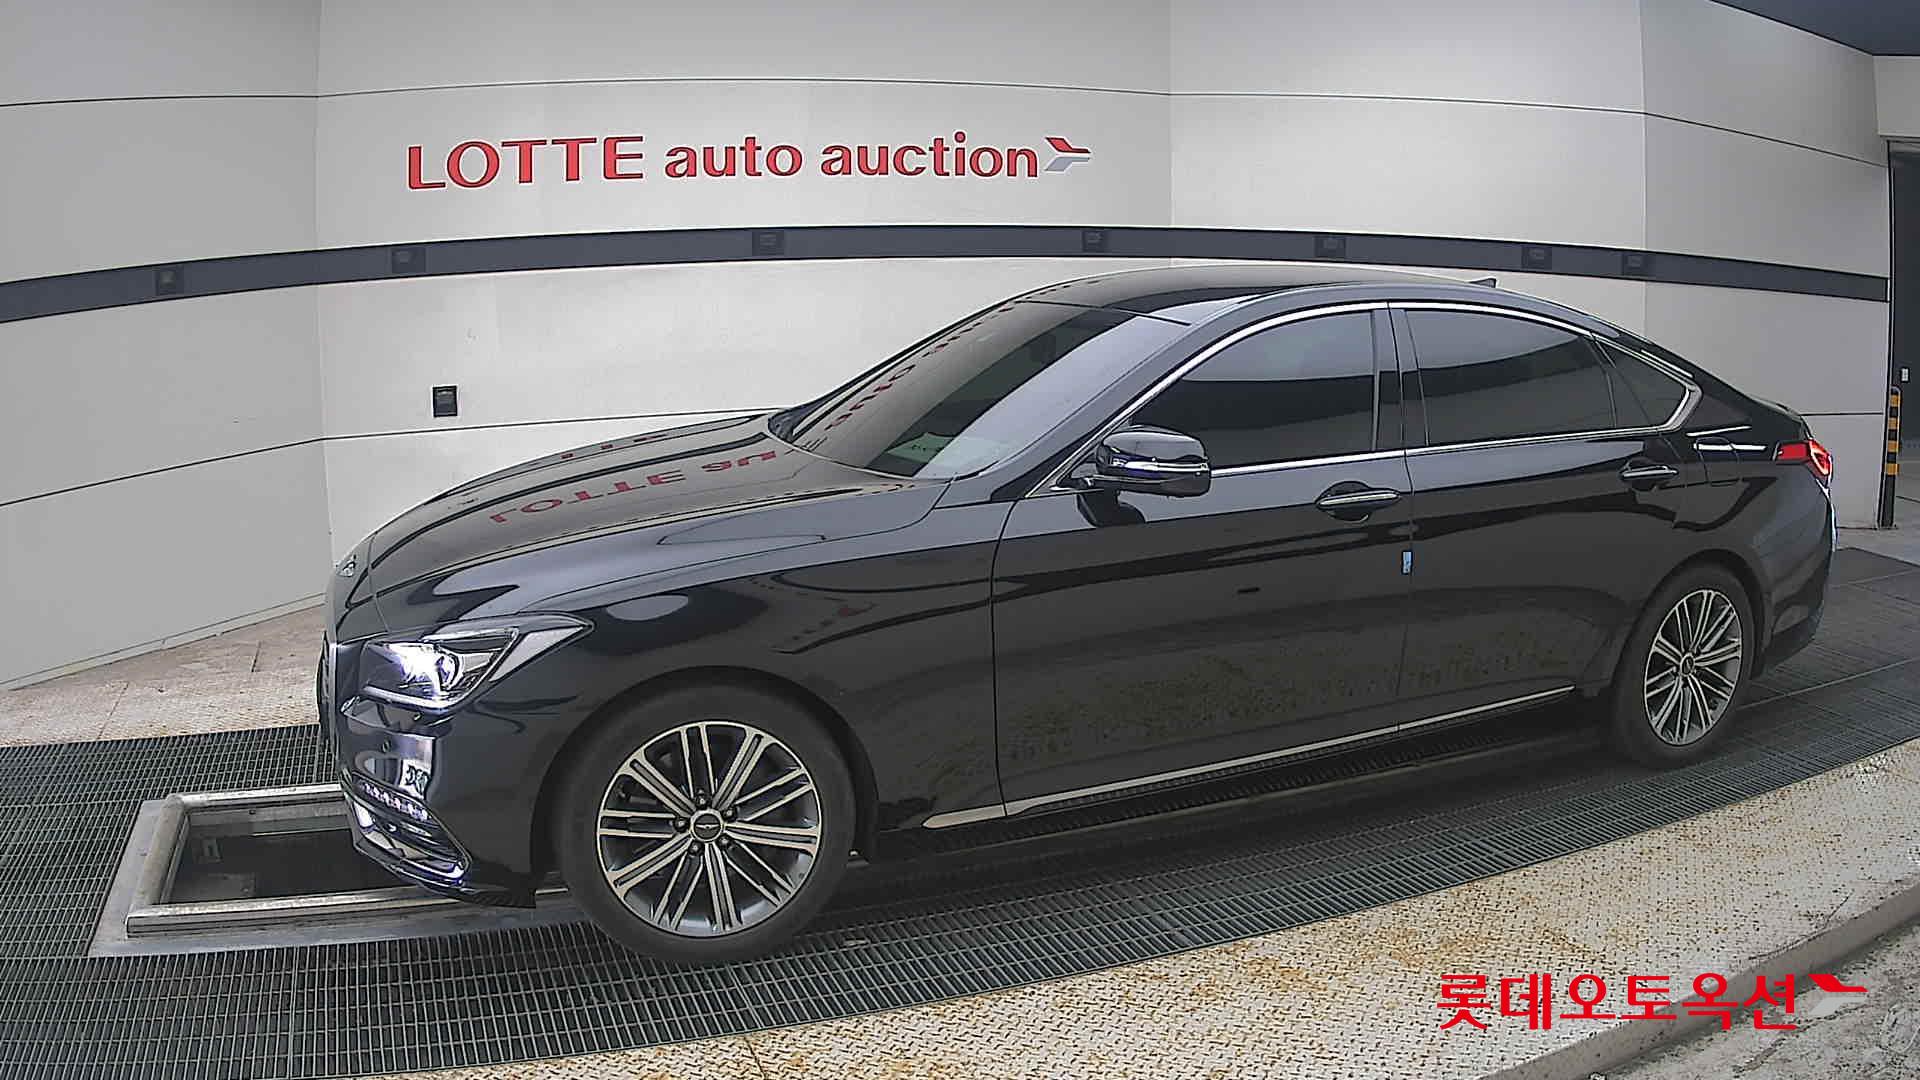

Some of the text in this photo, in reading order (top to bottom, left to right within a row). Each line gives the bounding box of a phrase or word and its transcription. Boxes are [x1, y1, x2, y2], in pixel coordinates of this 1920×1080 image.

[406, 131, 1039, 190] LOTTE auto auction
